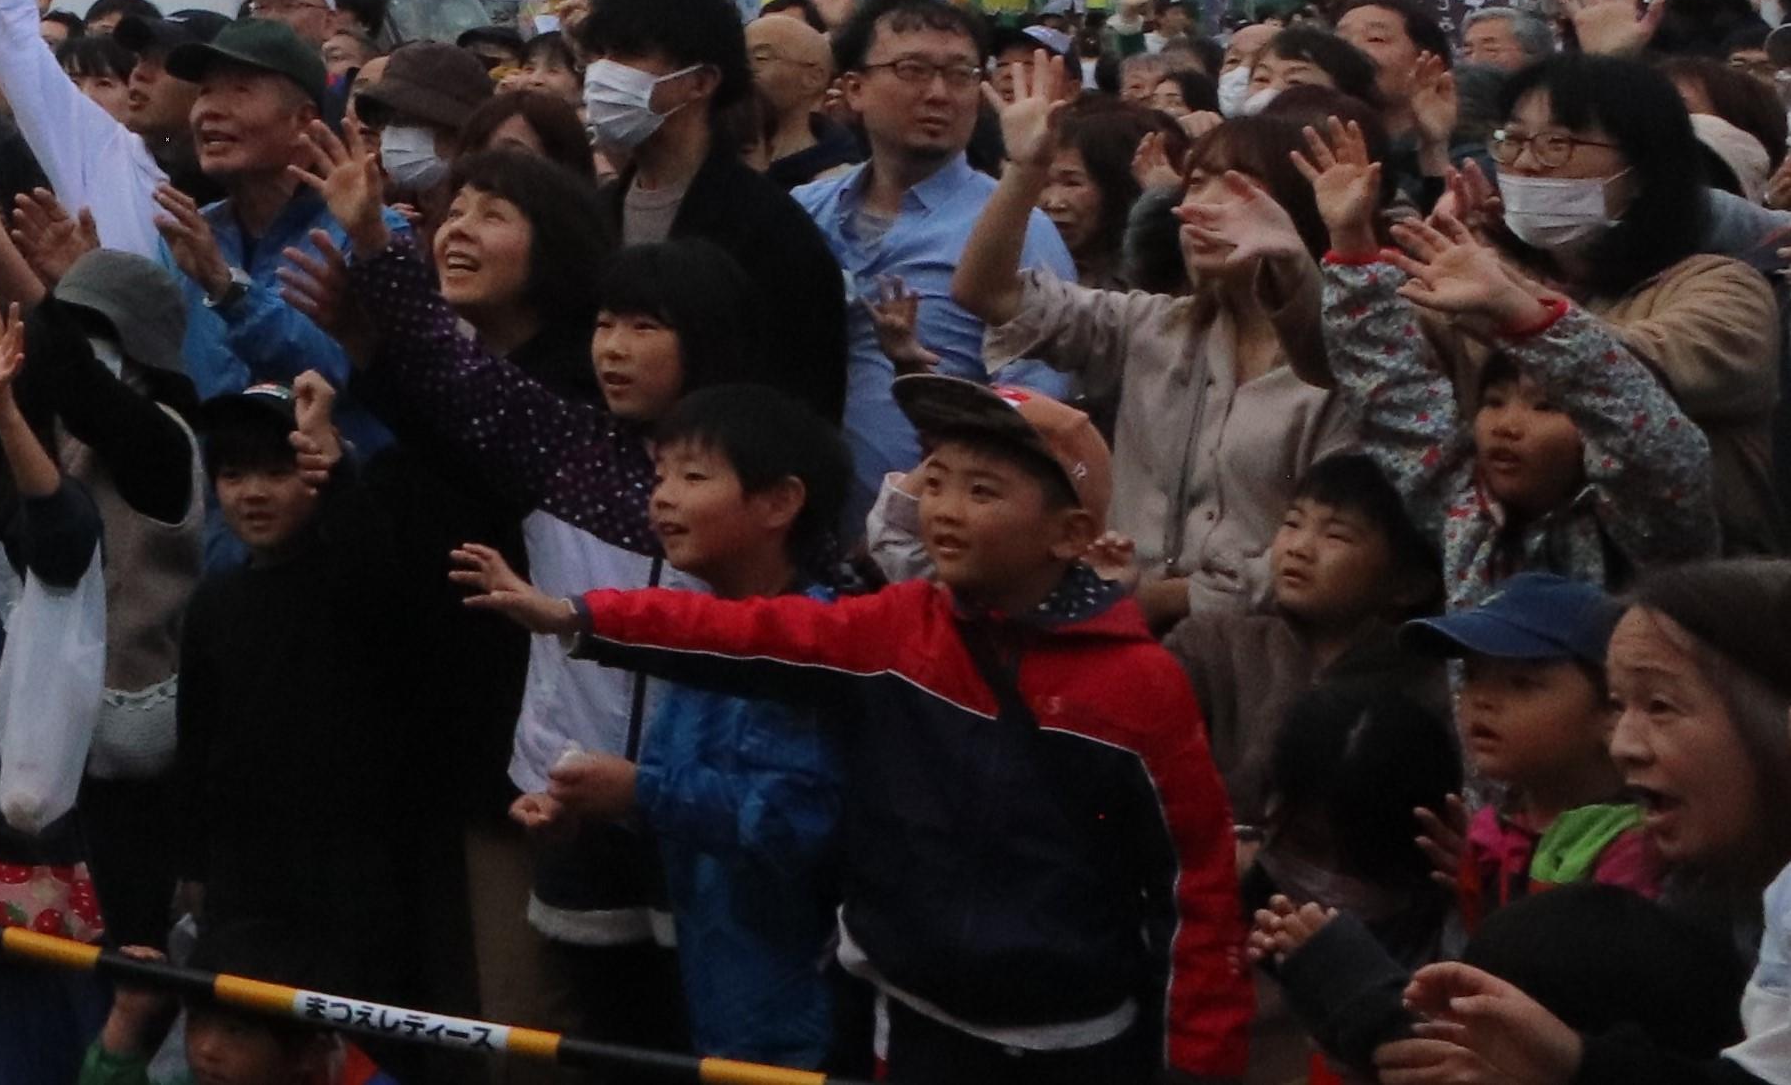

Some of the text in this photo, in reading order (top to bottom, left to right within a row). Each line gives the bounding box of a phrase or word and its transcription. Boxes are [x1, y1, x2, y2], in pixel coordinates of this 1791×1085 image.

[304, 996, 495, 1051] まつえレディース
